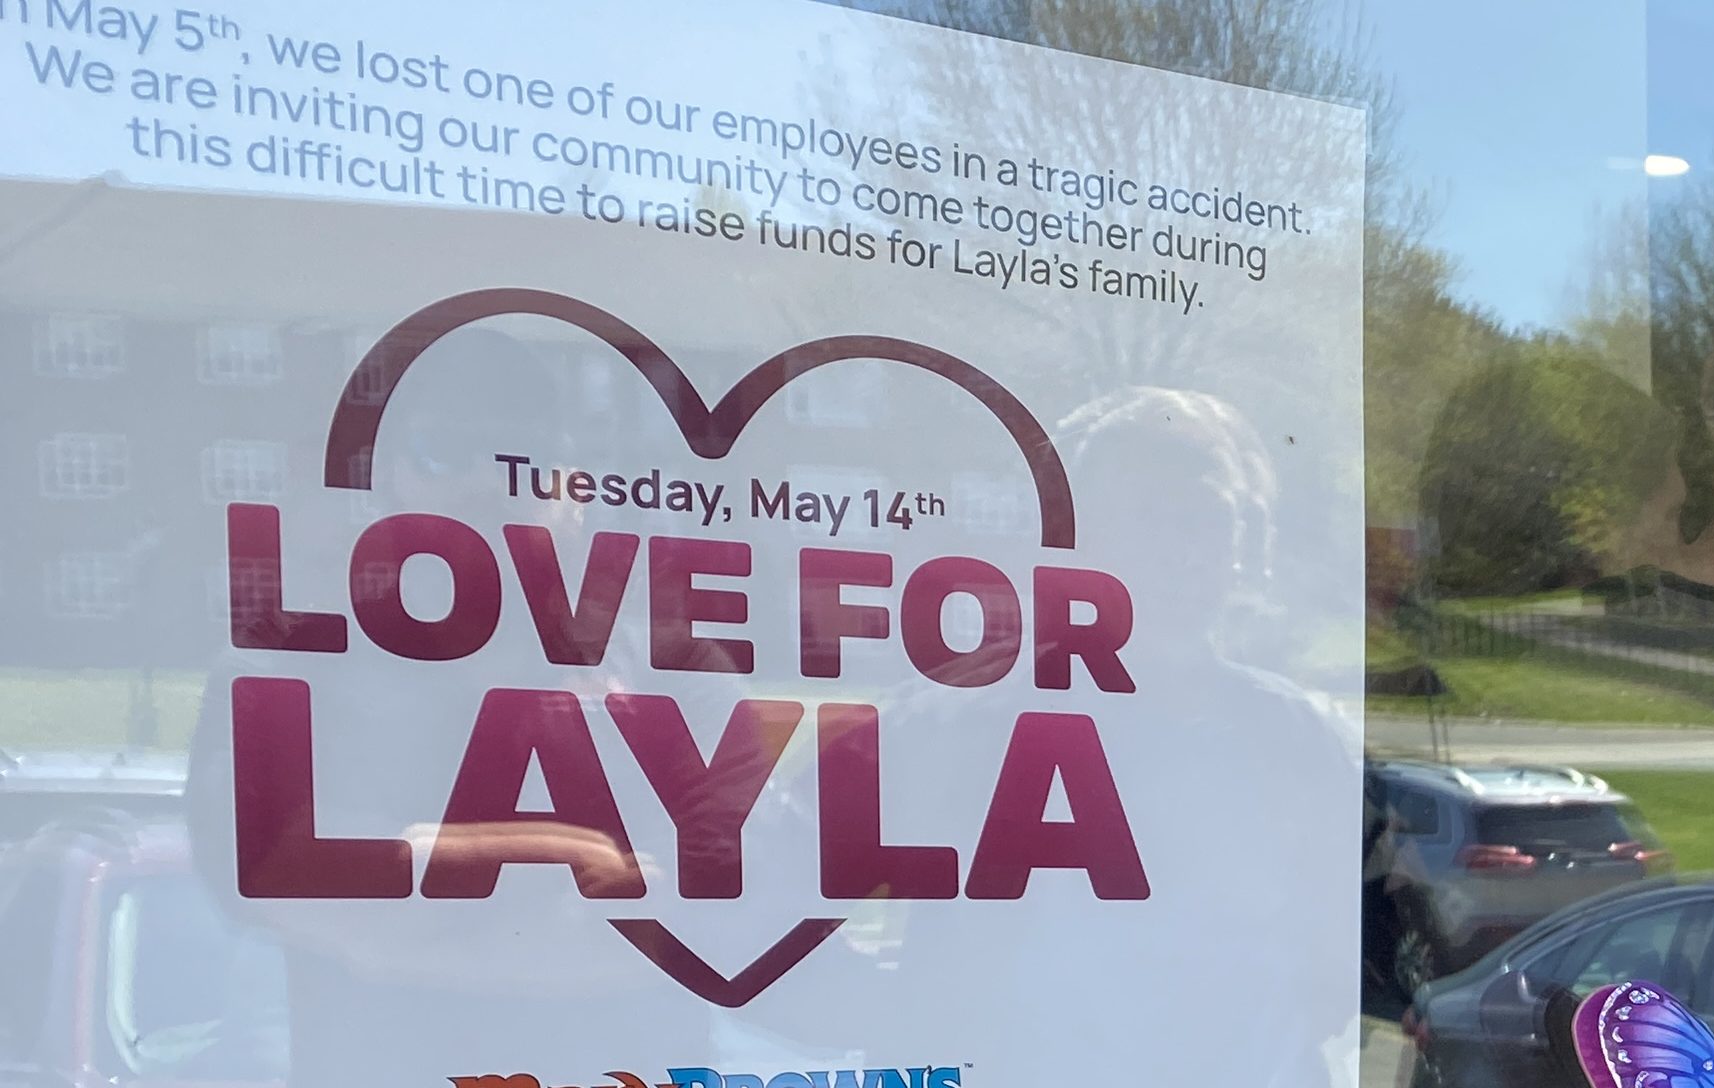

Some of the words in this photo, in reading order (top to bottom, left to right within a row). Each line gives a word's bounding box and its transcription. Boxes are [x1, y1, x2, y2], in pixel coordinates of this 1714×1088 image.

[26, 41, 114, 93] We
[130, 68, 217, 108] are
[233, 74, 424, 151] inviting
[438, 115, 520, 155] our
[532, 130, 788, 200] community
[799, 168, 842, 205] to
[852, 180, 964, 226] come
[974, 196, 1142, 252] together
[1152, 218, 1267, 280] during
[47, 0, 158, 54] May
[267, 34, 341, 74] we
[357, 41, 450, 93] lost
[463, 67, 554, 108] one
[567, 82, 614, 116] of
[626, 97, 701, 135] our
[713, 110, 941, 175] employees
[952, 143, 986, 182] in
[996, 161, 1018, 187] a
[1028, 158, 1138, 210] tragic
[1147, 182, 1312, 236] accident.
[126, 116, 233, 167] this
[246, 135, 446, 198] difficult
[456, 165, 565, 214] time
[577, 184, 625, 224] to
[638, 198, 744, 241] raise
[757, 210, 876, 261] funds
[887, 229, 943, 270] for
[953, 240, 1079, 291] Layla's
[1089, 258, 1204, 315] family.
[227, 501, 755, 674] LOVE
[799, 547, 1137, 695] FOR
[494, 454, 734, 526] Tuesday,
[751, 478, 851, 537] May
[231, 676, 1151, 900] LAYLA
